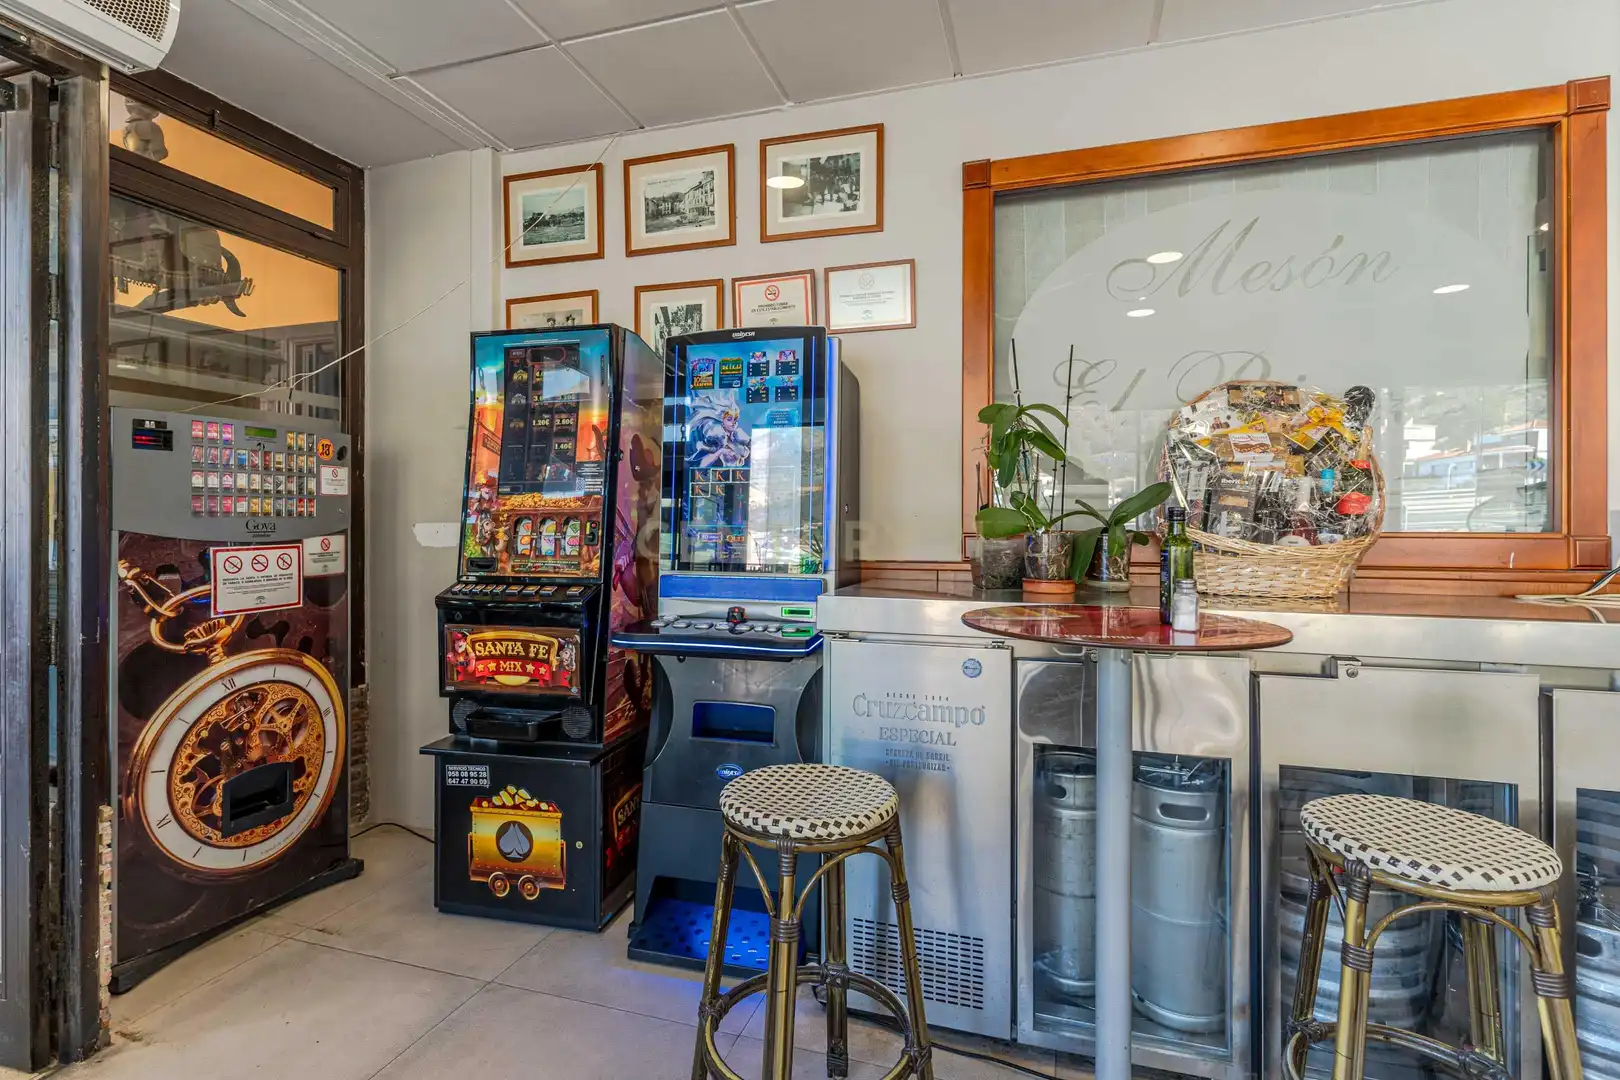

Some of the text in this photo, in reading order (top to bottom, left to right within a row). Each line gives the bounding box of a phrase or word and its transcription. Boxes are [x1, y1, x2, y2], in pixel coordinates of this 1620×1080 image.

[1106, 216, 1399, 302] Mesón
[1052, 357, 1147, 412] El
[475, 641, 549, 659] SANTA FE
[499, 660, 523, 673] MIX
[852, 692, 986, 728] Cruzcampo
[879, 726, 957, 747] ESPECIAL
